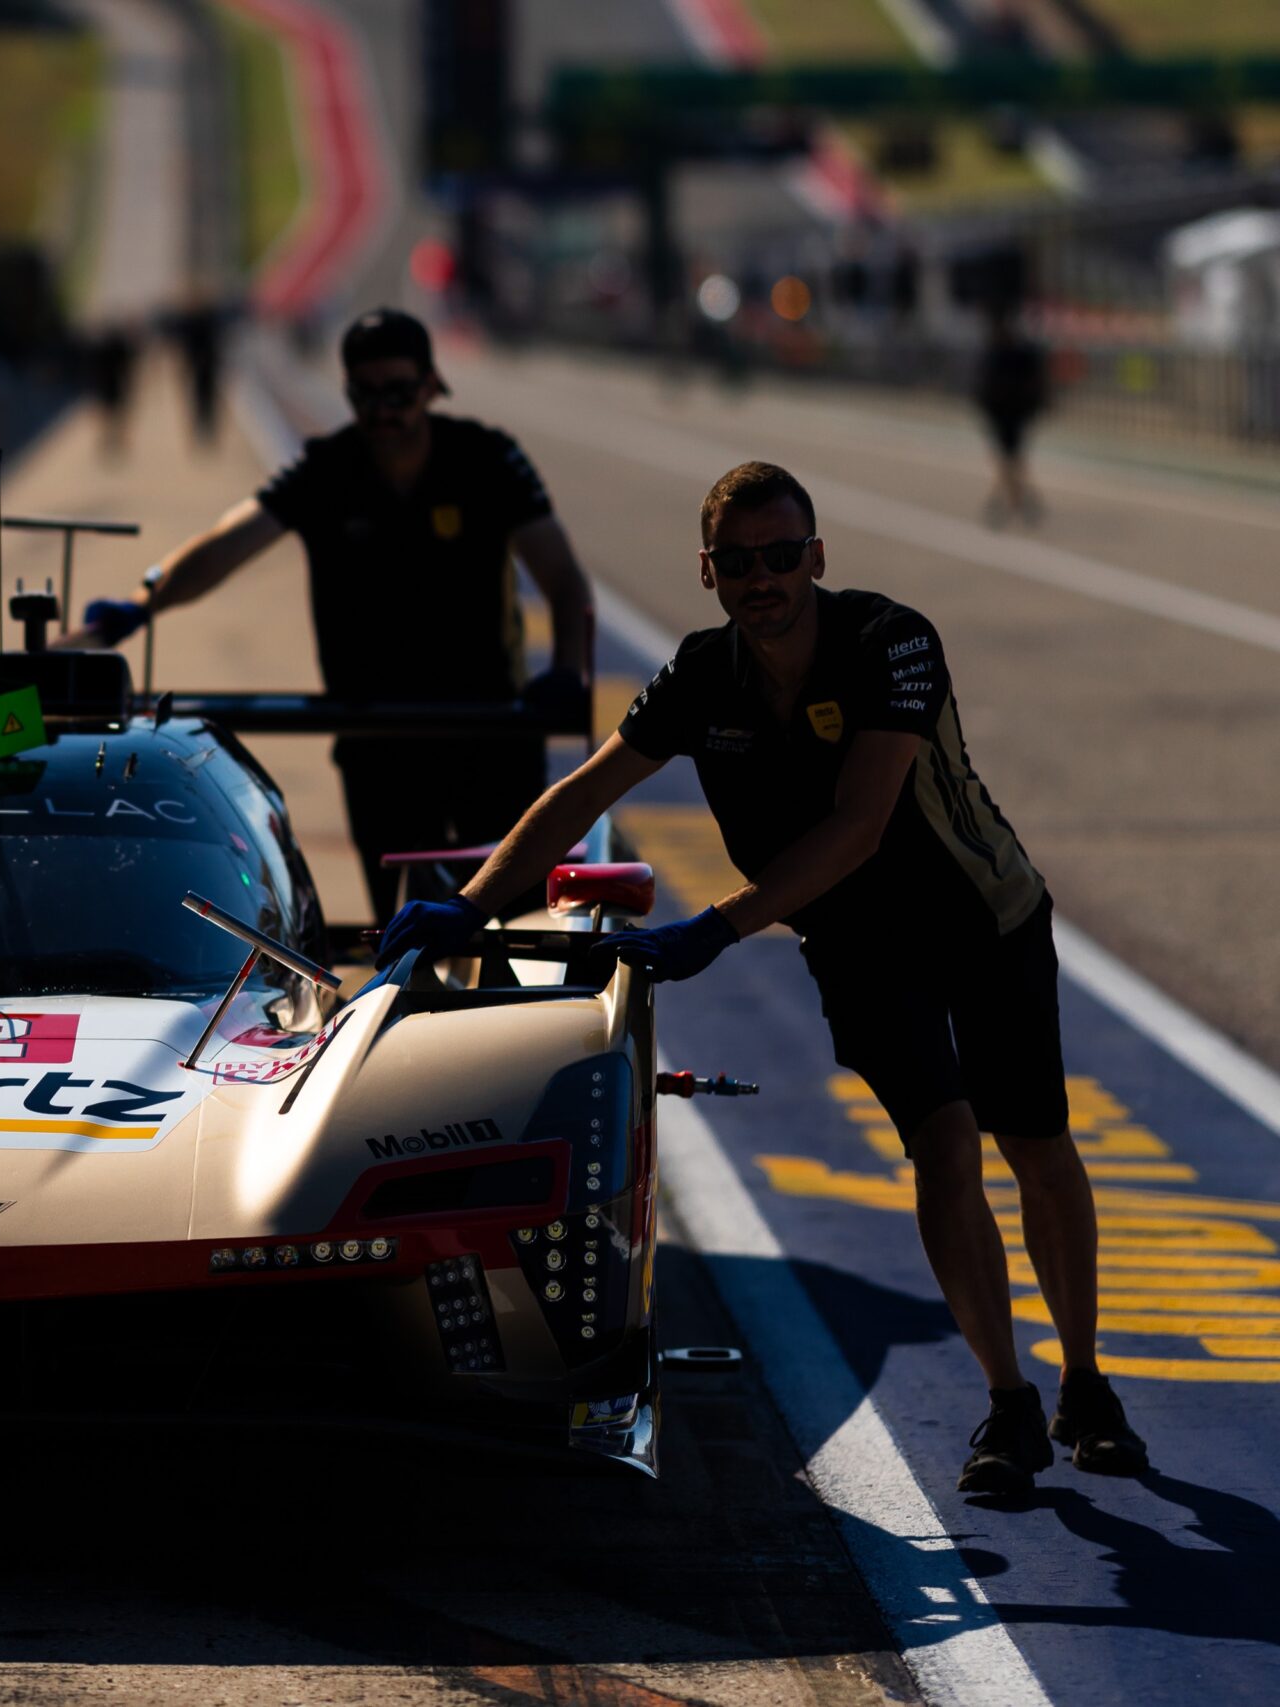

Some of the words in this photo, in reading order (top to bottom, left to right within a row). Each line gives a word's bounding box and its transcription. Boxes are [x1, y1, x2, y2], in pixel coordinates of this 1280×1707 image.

[888, 636, 928, 659] Hertz
[892, 661, 926, 681] Mobil
[365, 1123, 470, 1159] Mobil
